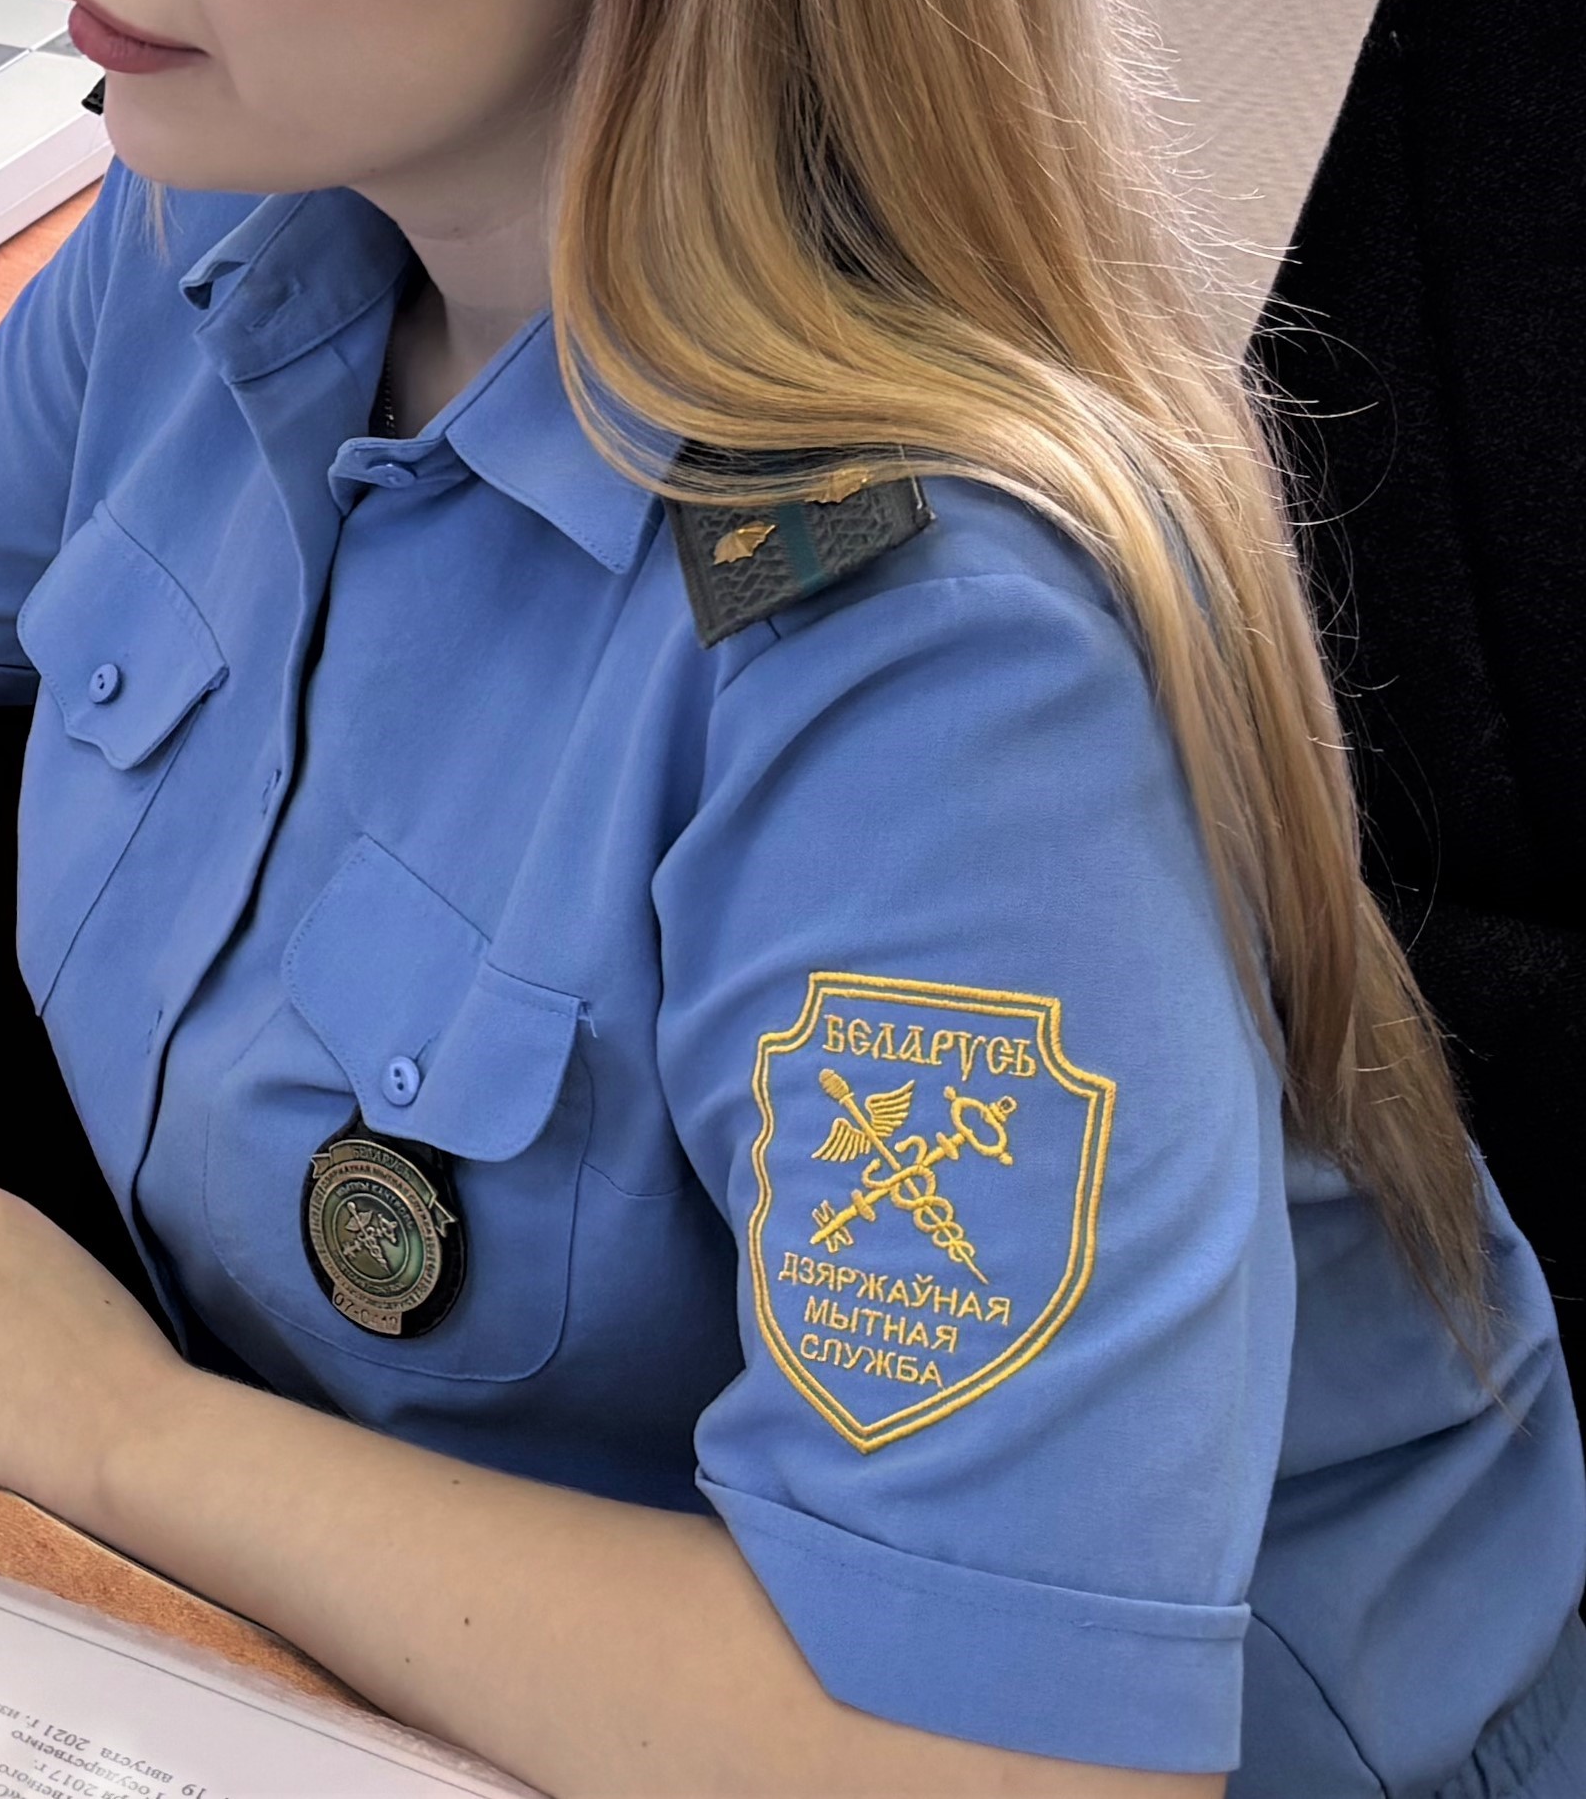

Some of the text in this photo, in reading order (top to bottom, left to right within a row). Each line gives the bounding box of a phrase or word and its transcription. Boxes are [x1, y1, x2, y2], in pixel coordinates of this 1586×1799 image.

[822, 1013, 1037, 1081] БЕЛАРУСЬ
[778, 1251, 1011, 1327] ДЗЯРЖАЎНАЯ
[804, 1294, 958, 1354] МЫТНАЯ
[800, 1333, 945, 1388] СЛУЖБА
[42, 1724, 91, 1751] 2021
[100, 1747, 174, 1785] августа
